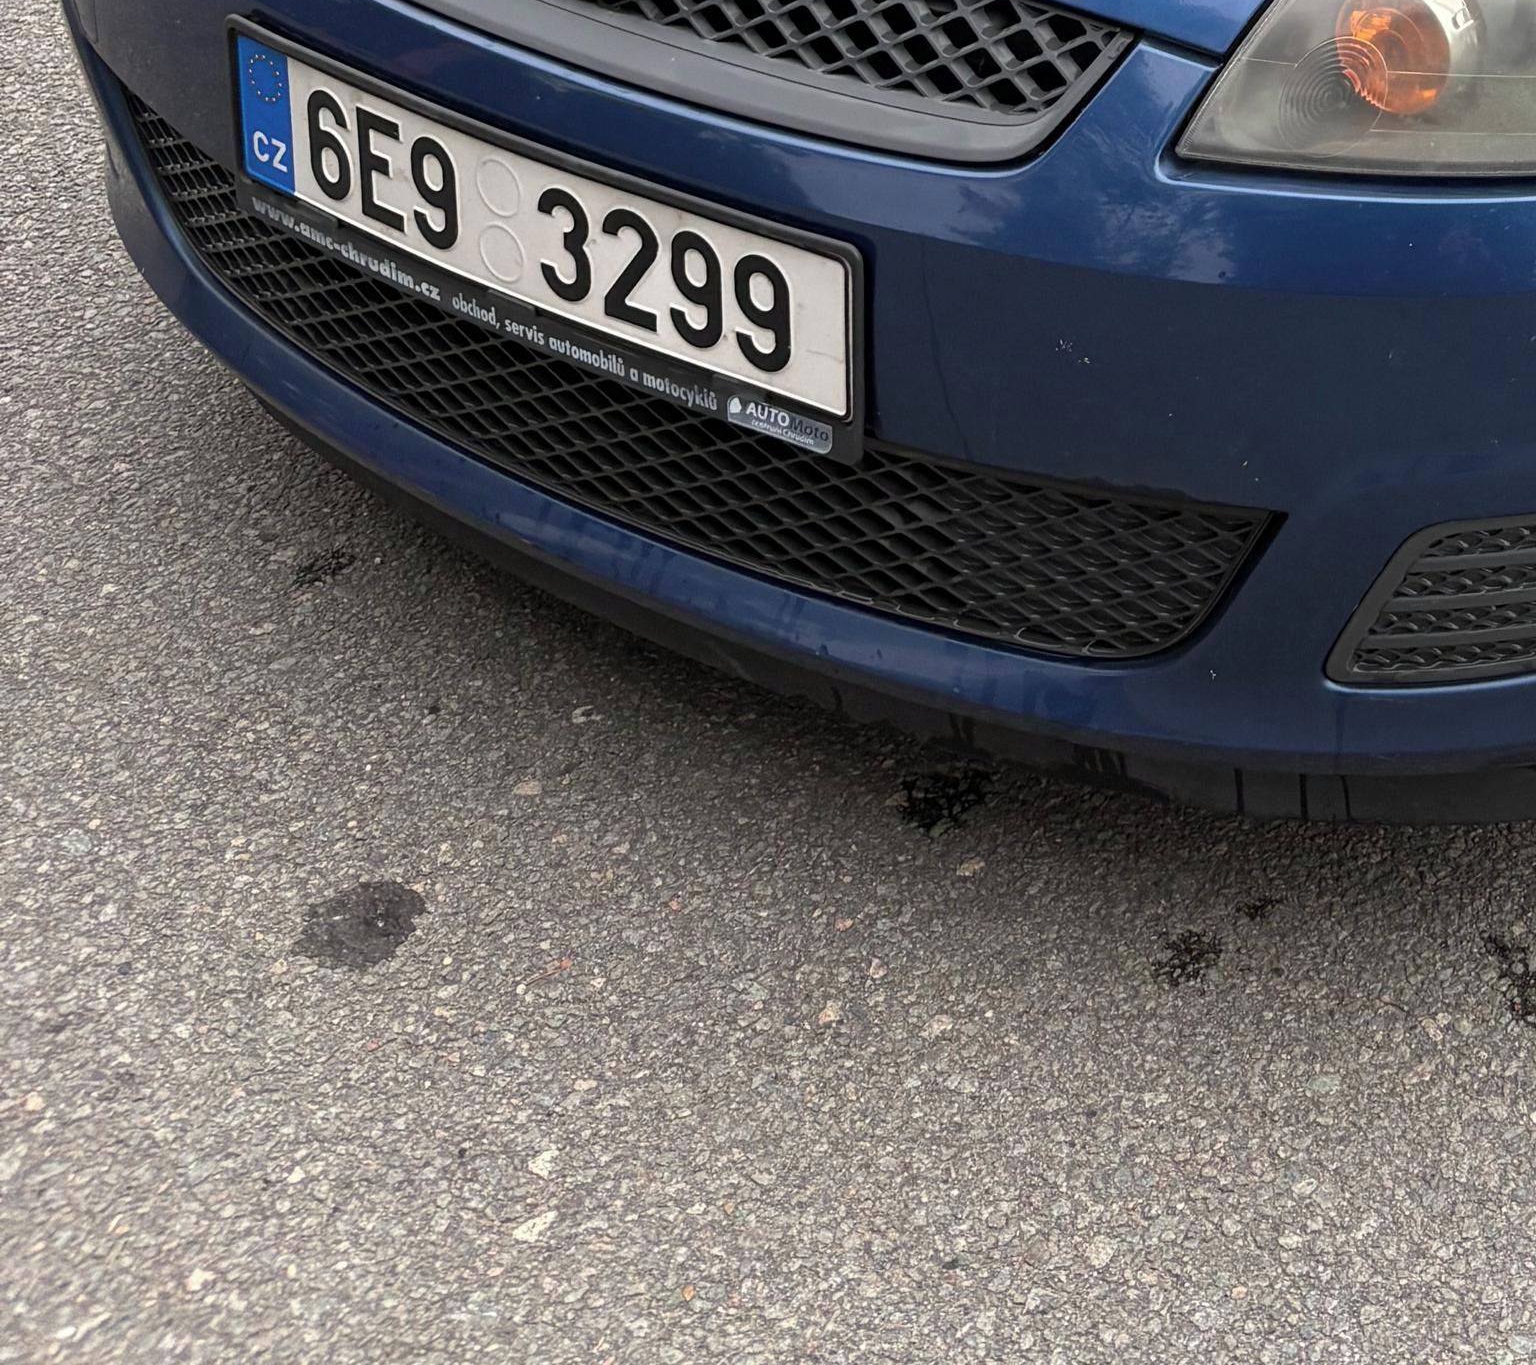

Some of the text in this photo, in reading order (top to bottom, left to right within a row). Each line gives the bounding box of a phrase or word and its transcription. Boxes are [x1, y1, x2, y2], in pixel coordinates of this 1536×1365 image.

[253, 130, 288, 173] CZ
[307, 89, 791, 373] 6E9 3299
[252, 197, 440, 302] www.amc-chrudim.cz
[452, 293, 500, 329] obchod,
[504, 319, 545, 345] servis
[549, 336, 625, 378] automobilů
[630, 367, 639, 382] a
